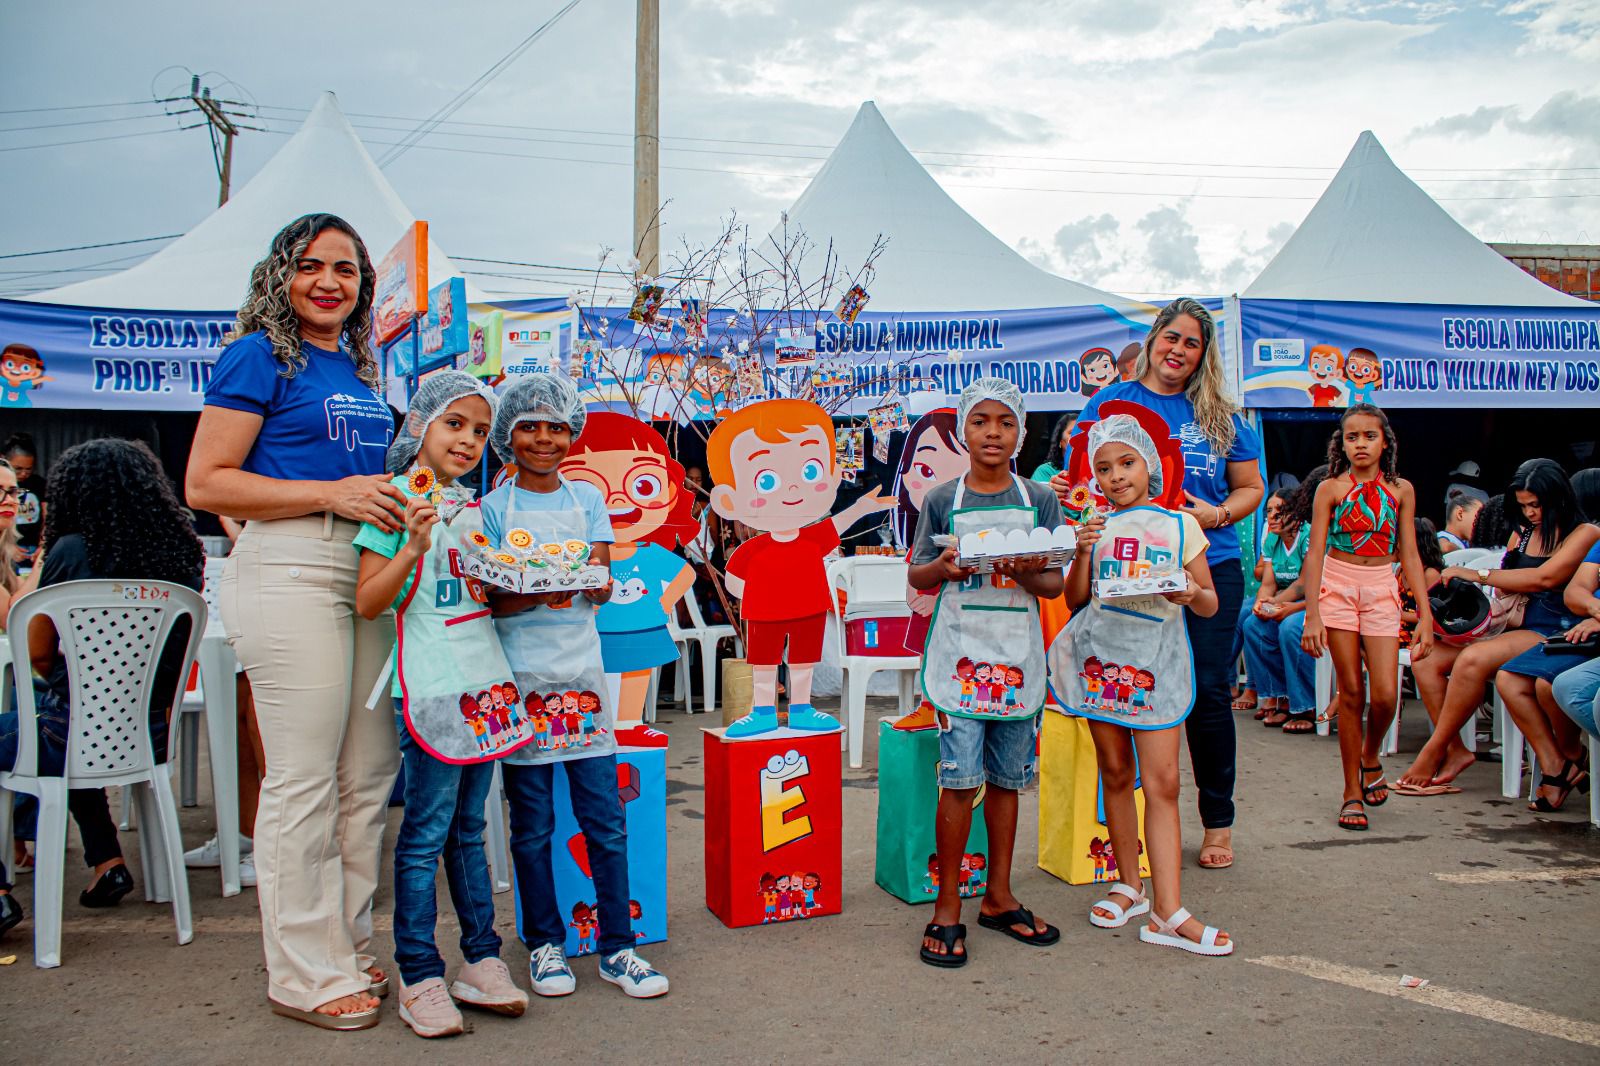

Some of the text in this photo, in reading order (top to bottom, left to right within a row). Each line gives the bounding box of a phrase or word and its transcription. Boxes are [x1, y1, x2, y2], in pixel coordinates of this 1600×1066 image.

[91, 317, 199, 348] ESCOLA
[815, 319, 1004, 352] ESCOLA MUNICIPAL
[1442, 318, 1600, 351] ESCOLA MUNICIPA
[94, 359, 182, 393] PROF.ª
[507, 365, 550, 374] SEBRAE
[1382, 358, 1600, 393] PAULO WILLIAN NEY DOS
[1122, 543, 1134, 558] E
[440, 583, 451, 602] J
[760, 754, 814, 854] E
